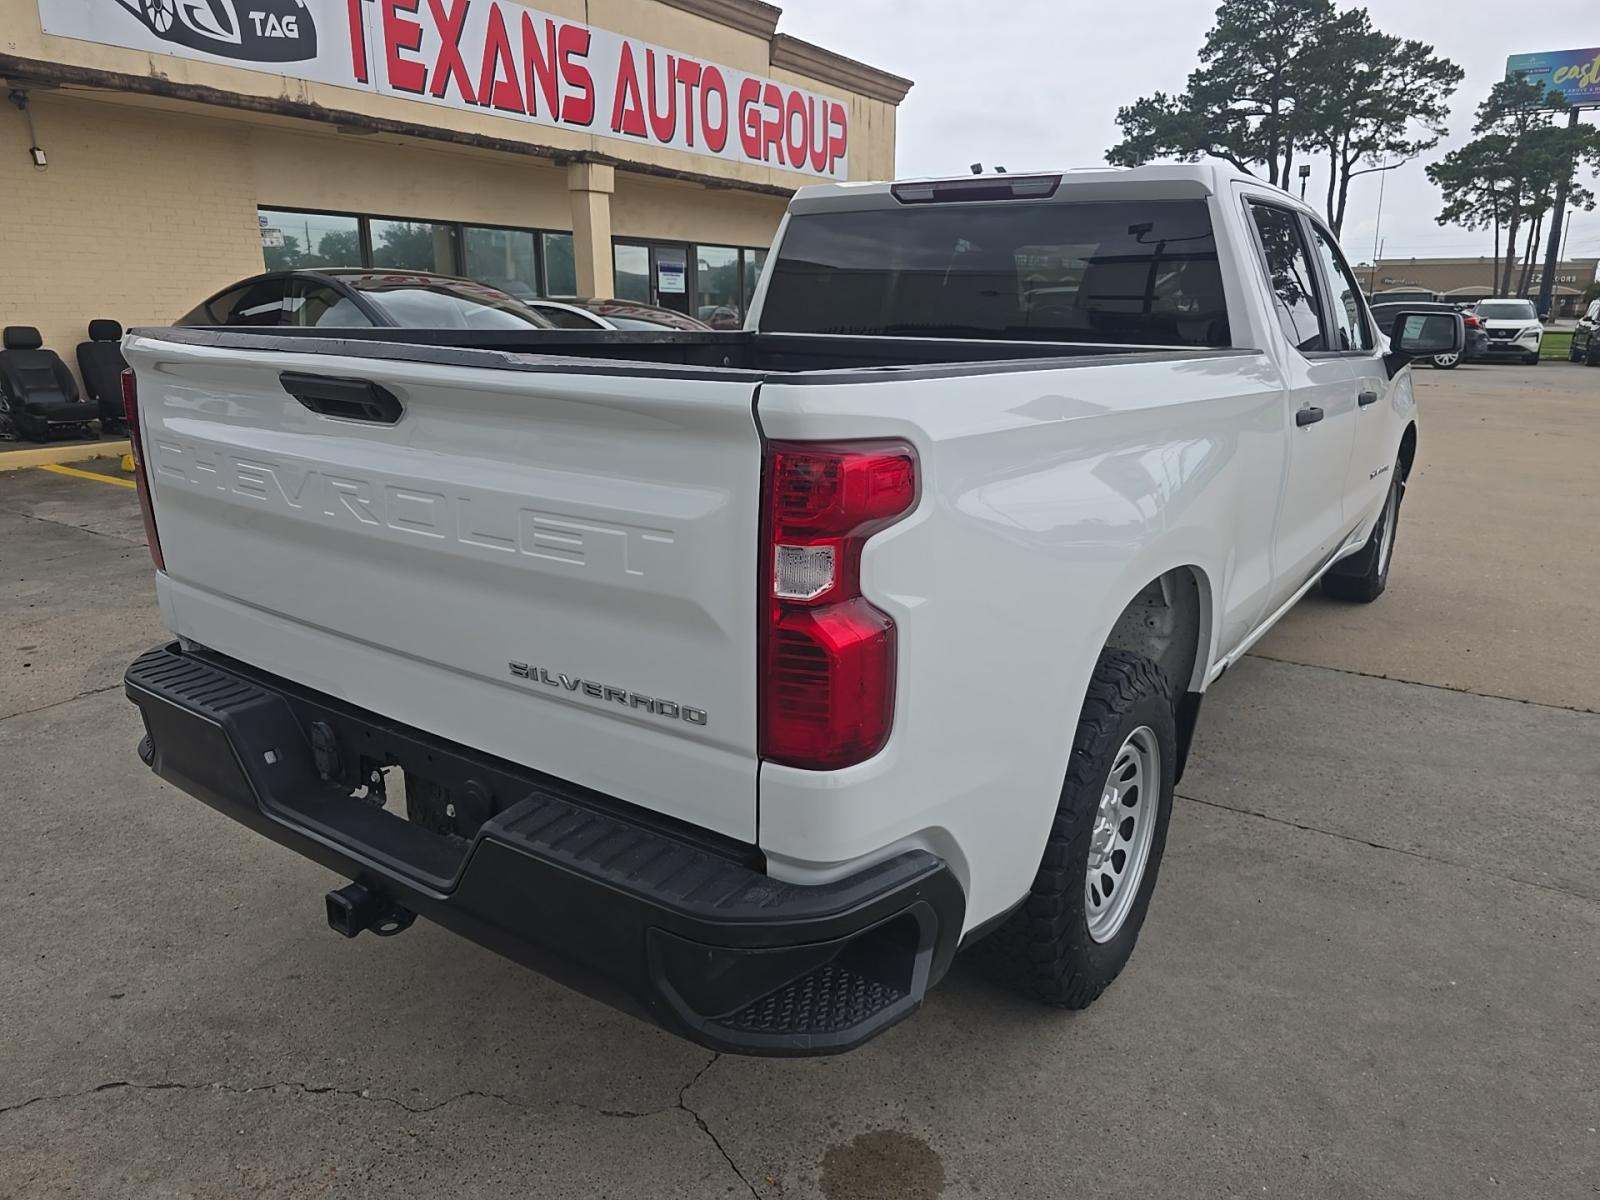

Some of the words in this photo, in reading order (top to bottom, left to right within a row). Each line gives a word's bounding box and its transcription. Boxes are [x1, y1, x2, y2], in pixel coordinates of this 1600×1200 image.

[249, 11, 299, 38] TAG
[347, 0, 594, 126] TEXANS
[612, 40, 728, 153] AUTO
[738, 77, 848, 175] GROUP
[155, 439, 675, 576] CHEVROLET
[508, 660, 708, 726] SILVERADO
